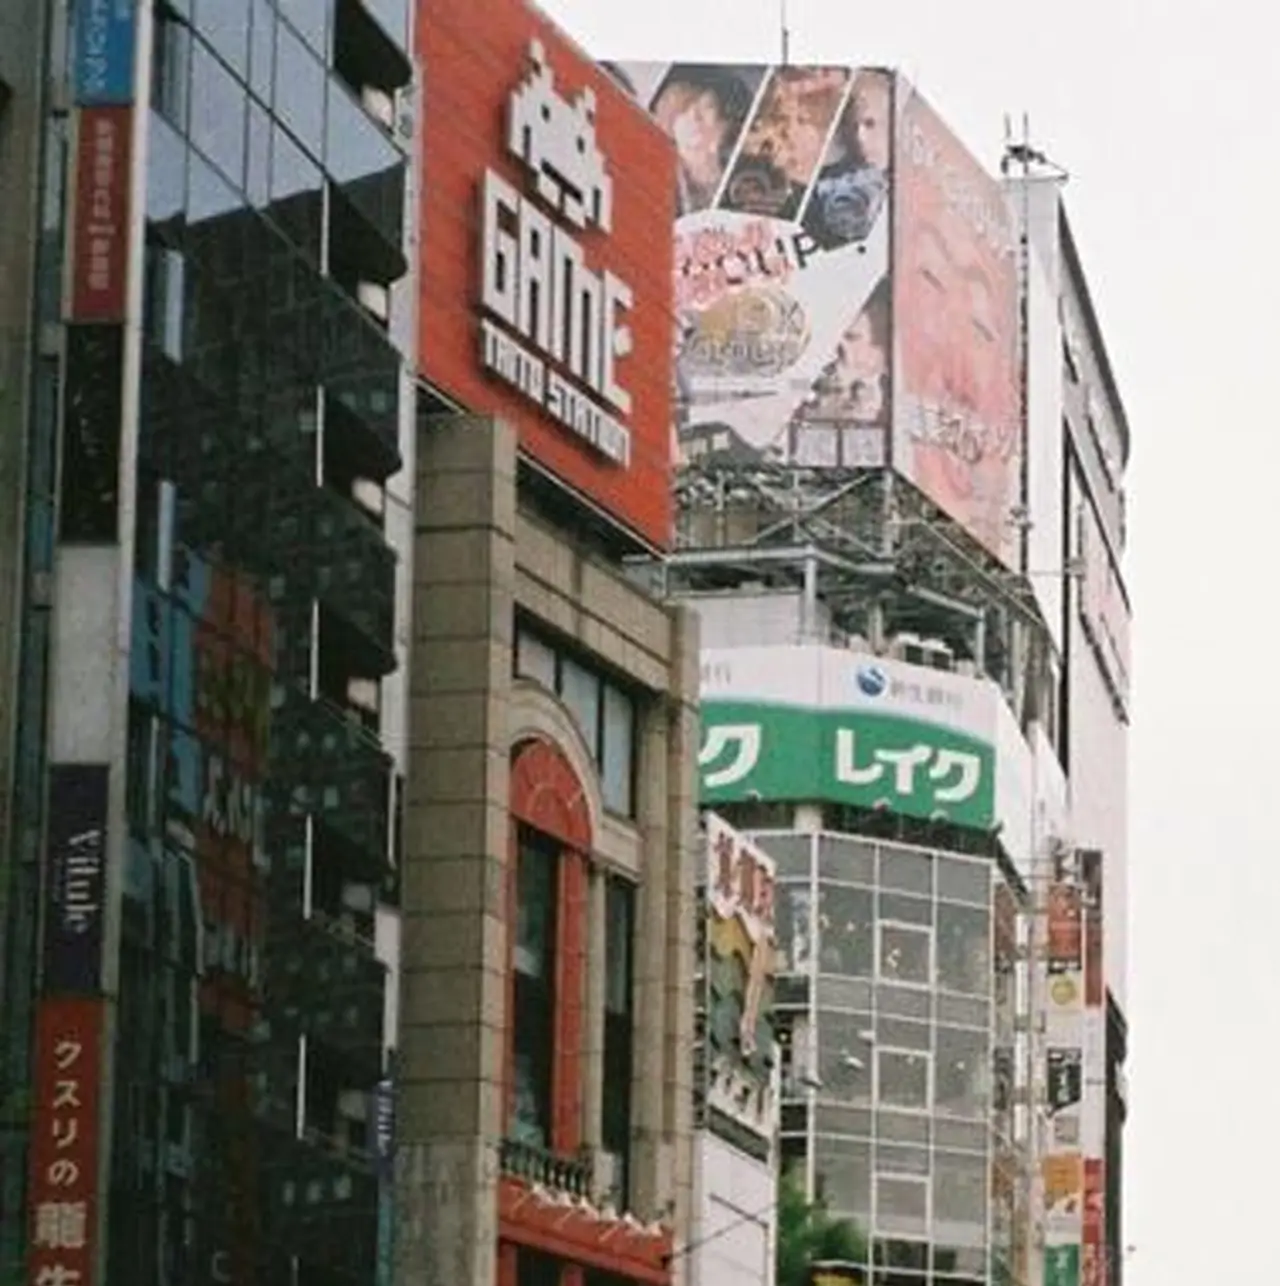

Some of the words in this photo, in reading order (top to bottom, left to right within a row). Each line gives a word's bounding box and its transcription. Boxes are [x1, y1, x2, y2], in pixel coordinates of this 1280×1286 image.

[485, 168, 632, 414] GAME
[698, 725, 762, 788] ク
[837, 728, 980, 801] レイク
